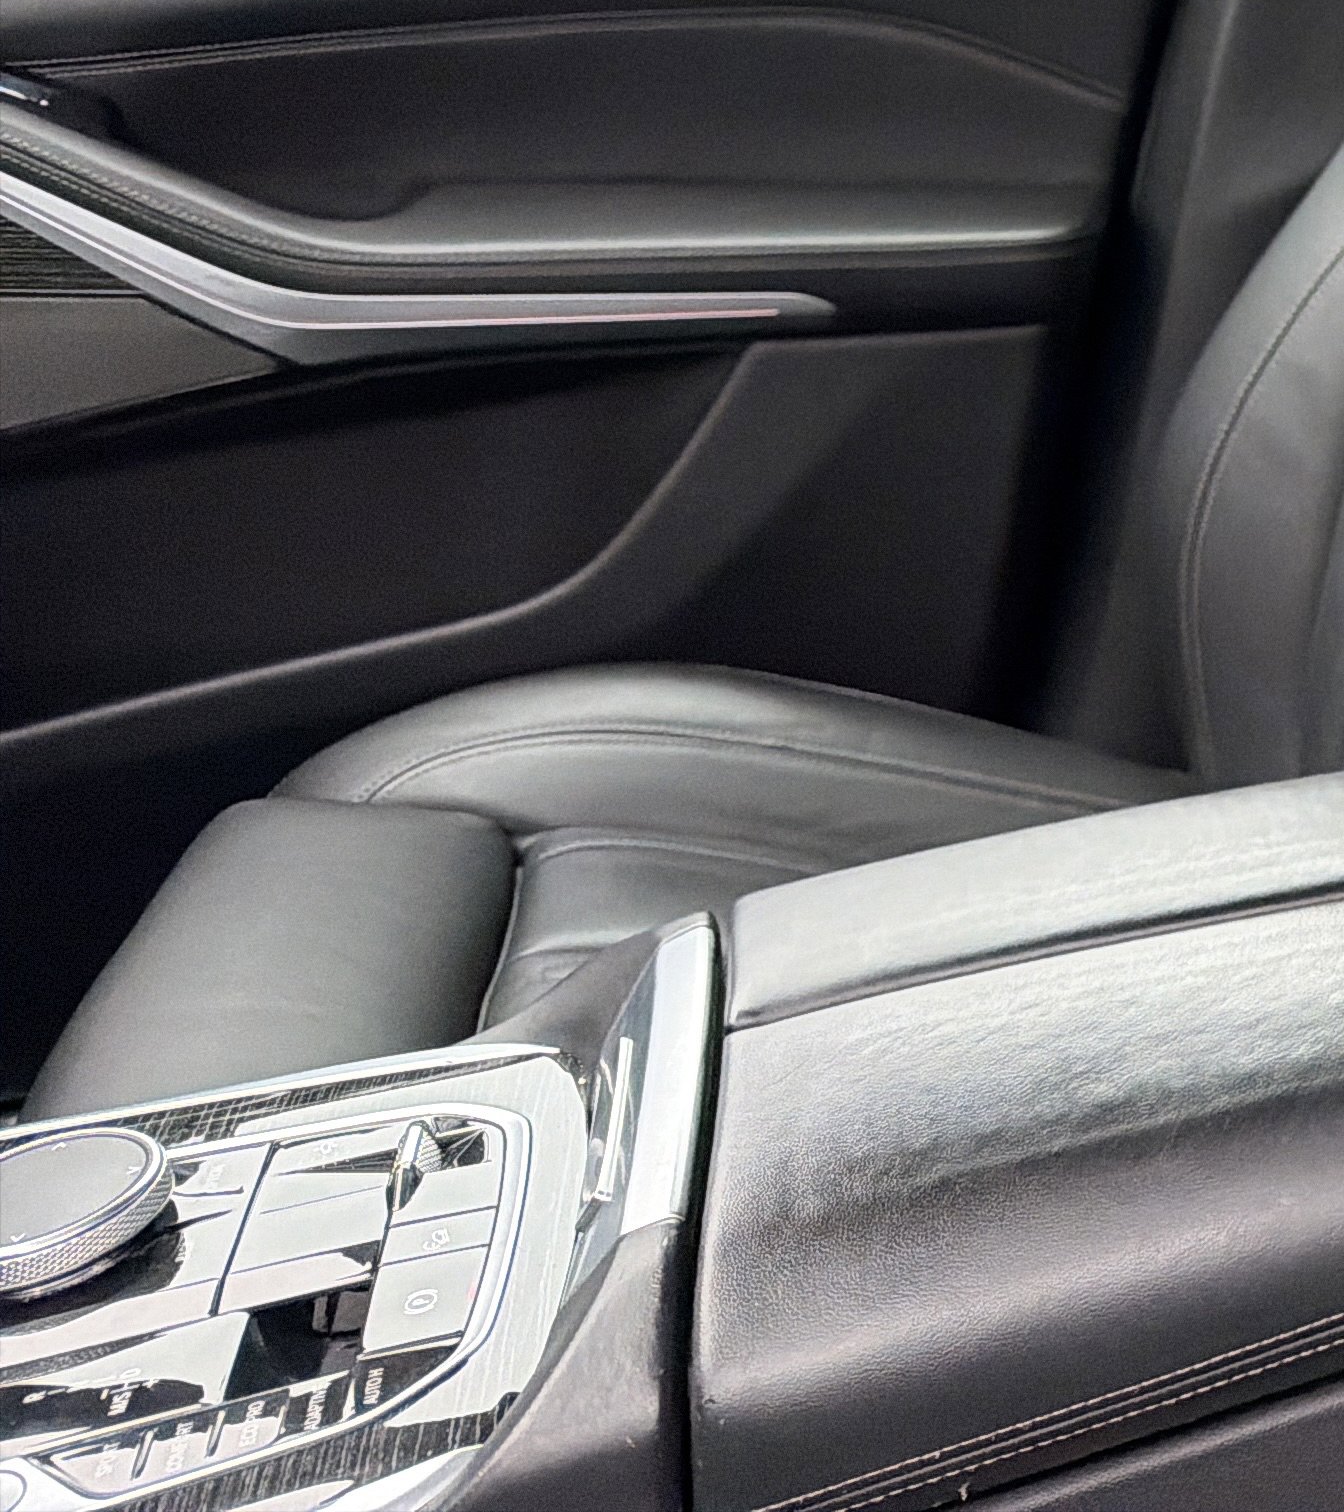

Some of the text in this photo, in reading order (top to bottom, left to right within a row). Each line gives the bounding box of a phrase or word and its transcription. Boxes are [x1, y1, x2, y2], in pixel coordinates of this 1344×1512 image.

[363, 1377, 382, 1405] AUTO
[238, 1400, 266, 1447] ECO PRO
